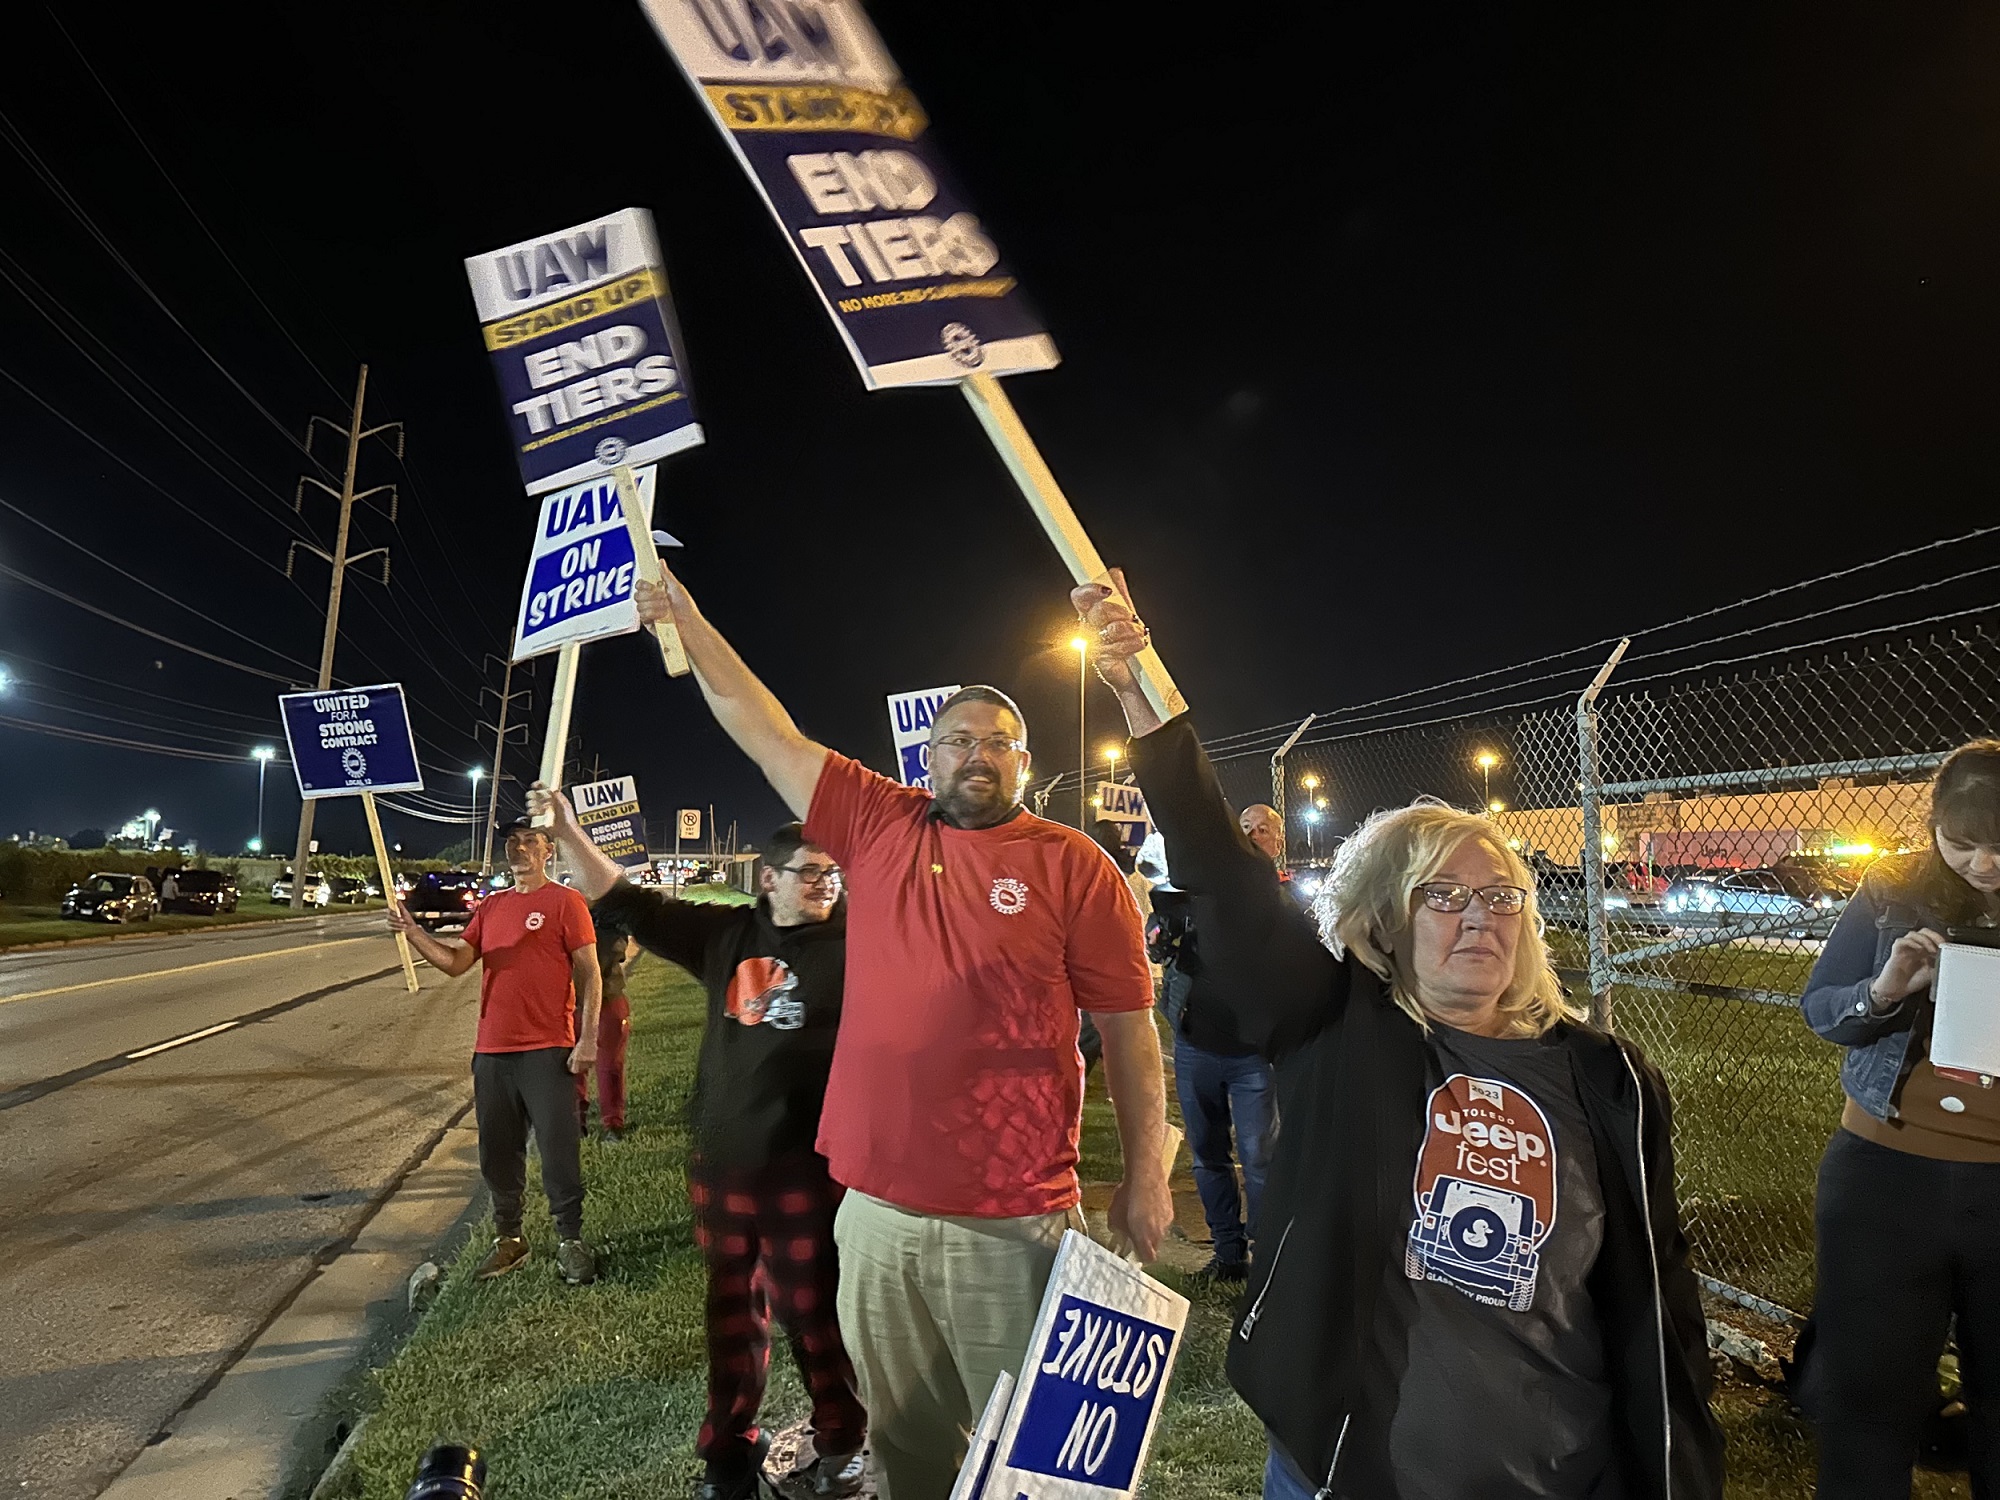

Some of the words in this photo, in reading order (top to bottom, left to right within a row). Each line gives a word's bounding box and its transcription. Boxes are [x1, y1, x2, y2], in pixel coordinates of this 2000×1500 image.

[787, 148, 938, 214] END
[495, 224, 623, 301] UAW
[800, 212, 1000, 287] TIERS
[494, 300, 596, 343] STAND
[602, 278, 643, 305] UP
[523, 325, 649, 390] END
[511, 354, 681, 435] TIERS
[560, 538, 602, 579] ON
[527, 561, 634, 627] STRIKE
[313, 694, 370, 712] UNITED
[331, 711, 350, 721] FOR
[351, 710, 358, 719] A
[319, 719, 375, 737] STRONG
[321, 734, 378, 749] CONTRACT
[583, 781, 624, 807] UAW
[1102, 787, 1144, 816] UAW
[582, 809, 618, 823] STAND
[620, 804, 635, 814] UP
[591, 820, 631, 835] RECORD
[593, 828, 633, 844] PROFITS
[600, 838, 634, 852] ECORD
[1471, 1085, 1499, 1100] 2023
[1462, 1108, 1515, 1125] TOLEDO
[1435, 1110, 1546, 1162] Jeep
[1456, 1141, 1520, 1185] fest
[1475, 1294, 1507, 1307] PROUD
[1042, 1308, 1165, 1399] STRIKE
[1056, 1400, 1117, 1476] ON
